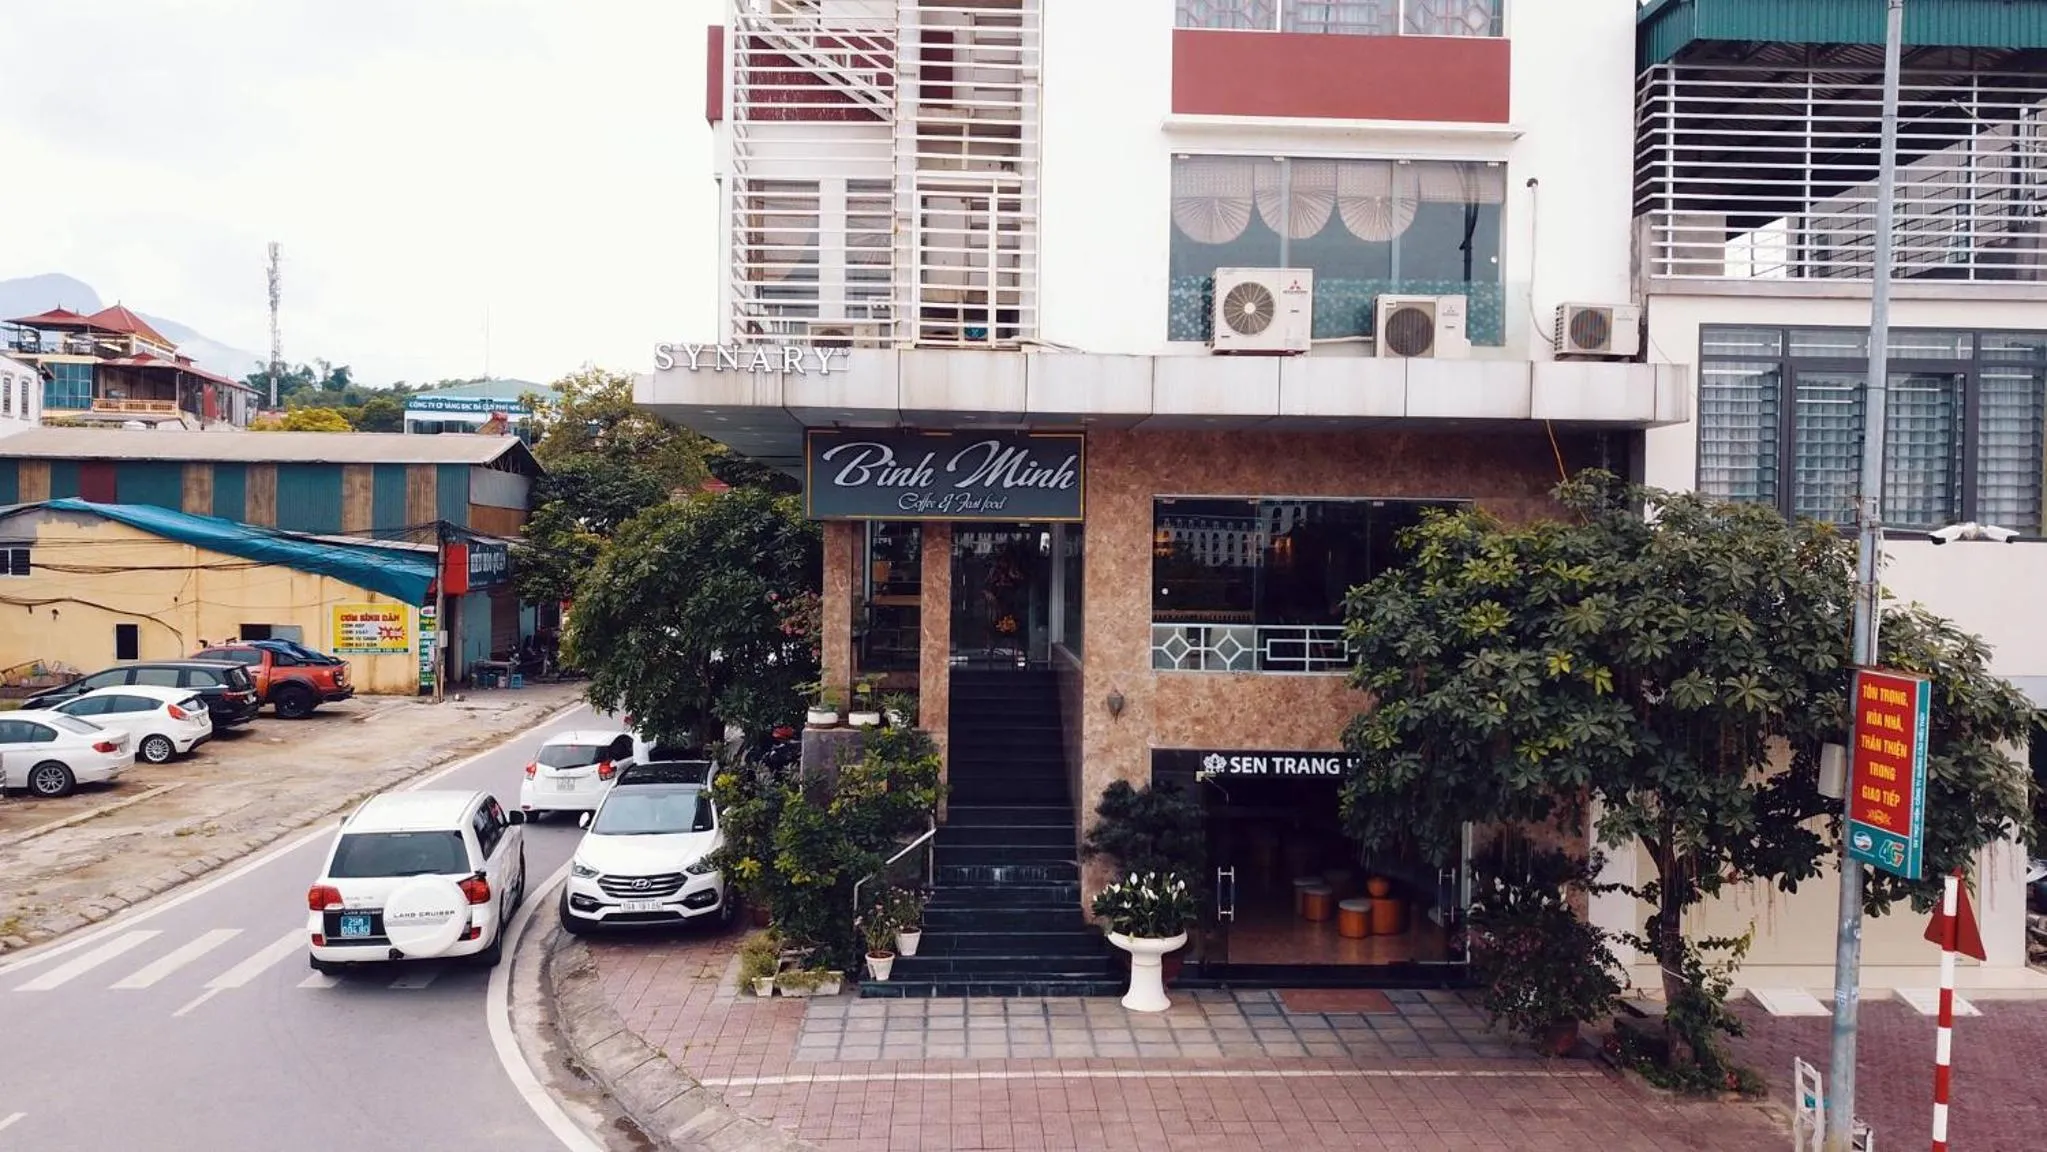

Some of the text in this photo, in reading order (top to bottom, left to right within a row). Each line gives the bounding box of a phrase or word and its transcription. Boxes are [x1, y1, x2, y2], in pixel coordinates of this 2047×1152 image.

[654, 344, 834, 375] SYNARY
[946, 440, 1077, 490] Minh
[898, 492, 936, 512] Coffee
[955, 492, 982, 512] Fast
[980, 494, 1008, 512] food
[1863, 682, 1908, 708] TÔN TRỌNG,
[1866, 709, 1882, 726] HÒA
[1861, 734, 1908, 759] THÂN THIỆN
[1230, 756, 1267, 774] SEN
[1272, 757, 1340, 774] TRANG
[1869, 761, 1896, 781] TRONG
[1862, 785, 1900, 807] GIAO TIẾP
